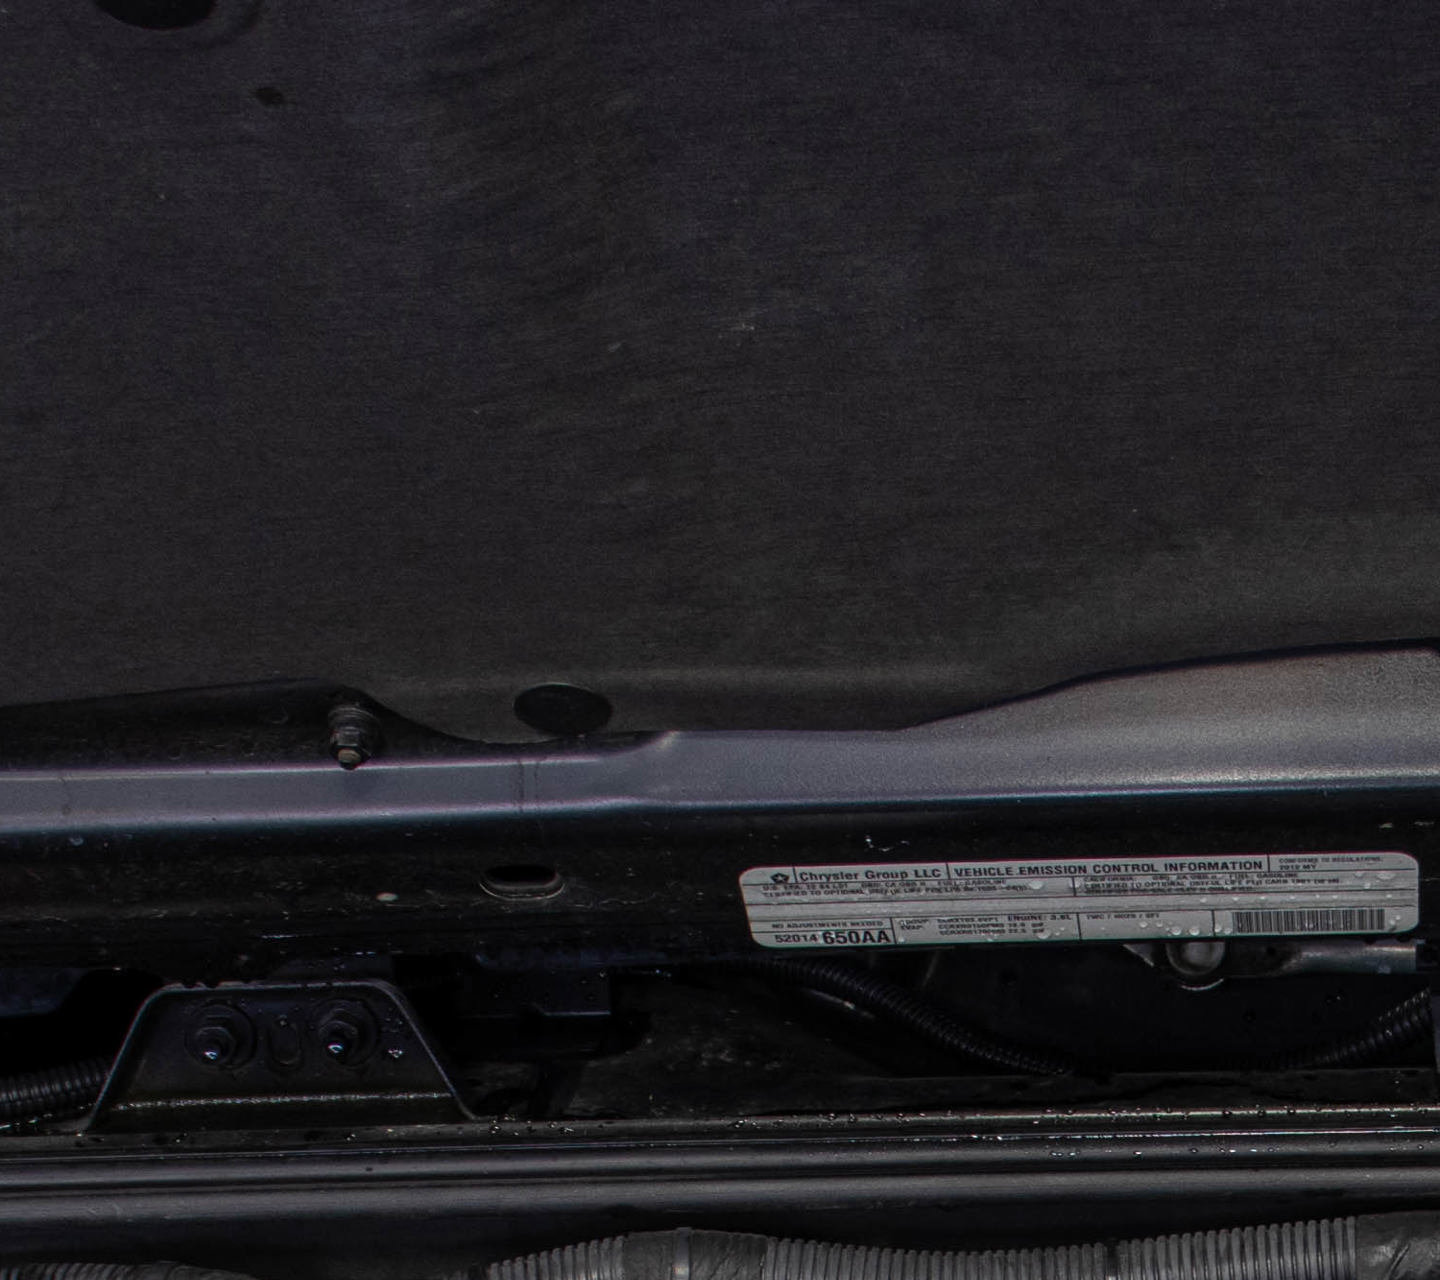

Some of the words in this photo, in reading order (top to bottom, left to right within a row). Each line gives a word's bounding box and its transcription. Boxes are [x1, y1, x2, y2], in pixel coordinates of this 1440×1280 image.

[799, 870, 858, 882] Chrysler
[865, 868, 908, 881] Group
[913, 868, 941, 879] LLC
[954, 866, 1013, 877] VEHICLE
[1019, 864, 1088, 876] EMISSION
[1092, 862, 1159, 874] CONTROL
[1164, 860, 1263, 872] INFORMATION
[775, 933, 818, 944] 52014
[822, 930, 891, 945] 650AA
